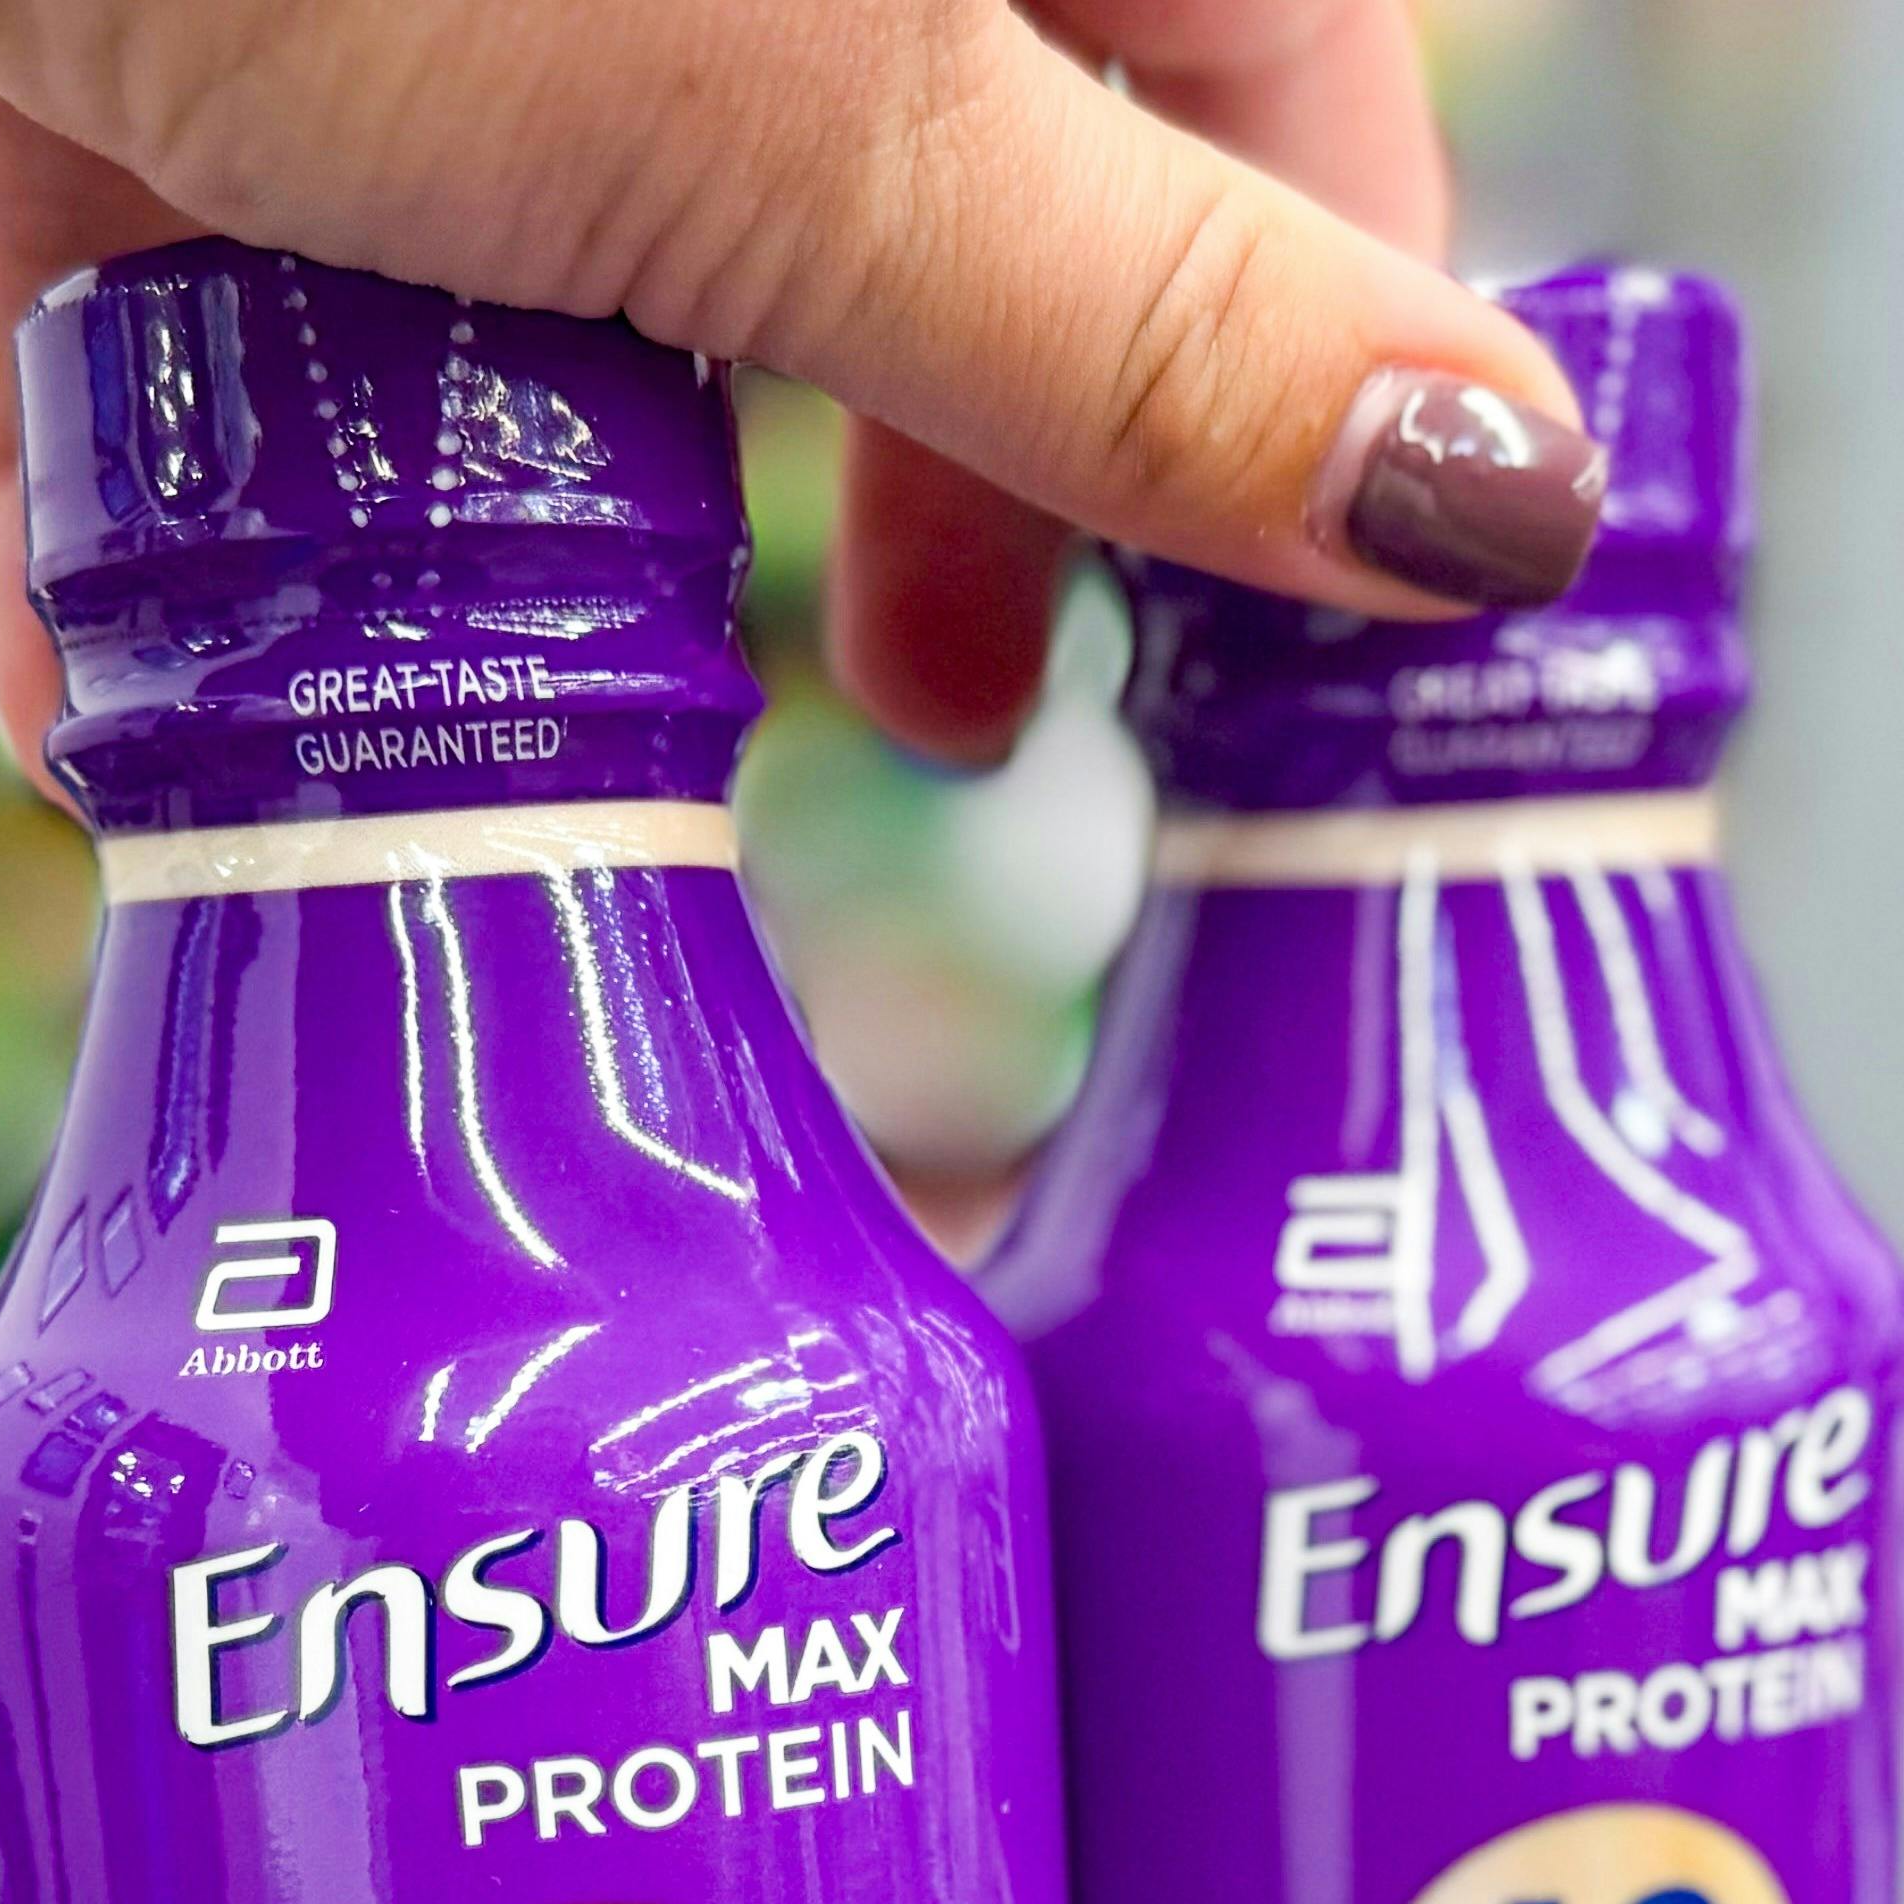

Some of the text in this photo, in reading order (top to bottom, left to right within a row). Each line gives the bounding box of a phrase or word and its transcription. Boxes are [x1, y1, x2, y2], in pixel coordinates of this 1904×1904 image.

[289, 654, 556, 716] GREAT TASTE
[295, 717, 560, 775] GUARANTEED
[179, 1342, 324, 1378] Abbott
[1255, 1385, 1872, 1662] Ensure
[170, 1431, 903, 1747] Ensure
[1715, 1541, 1869, 1652] MAX
[708, 1607, 911, 1715] MAX
[1507, 1633, 1866, 1761] PROTEIN
[458, 1710, 915, 1848] PROTEIN
